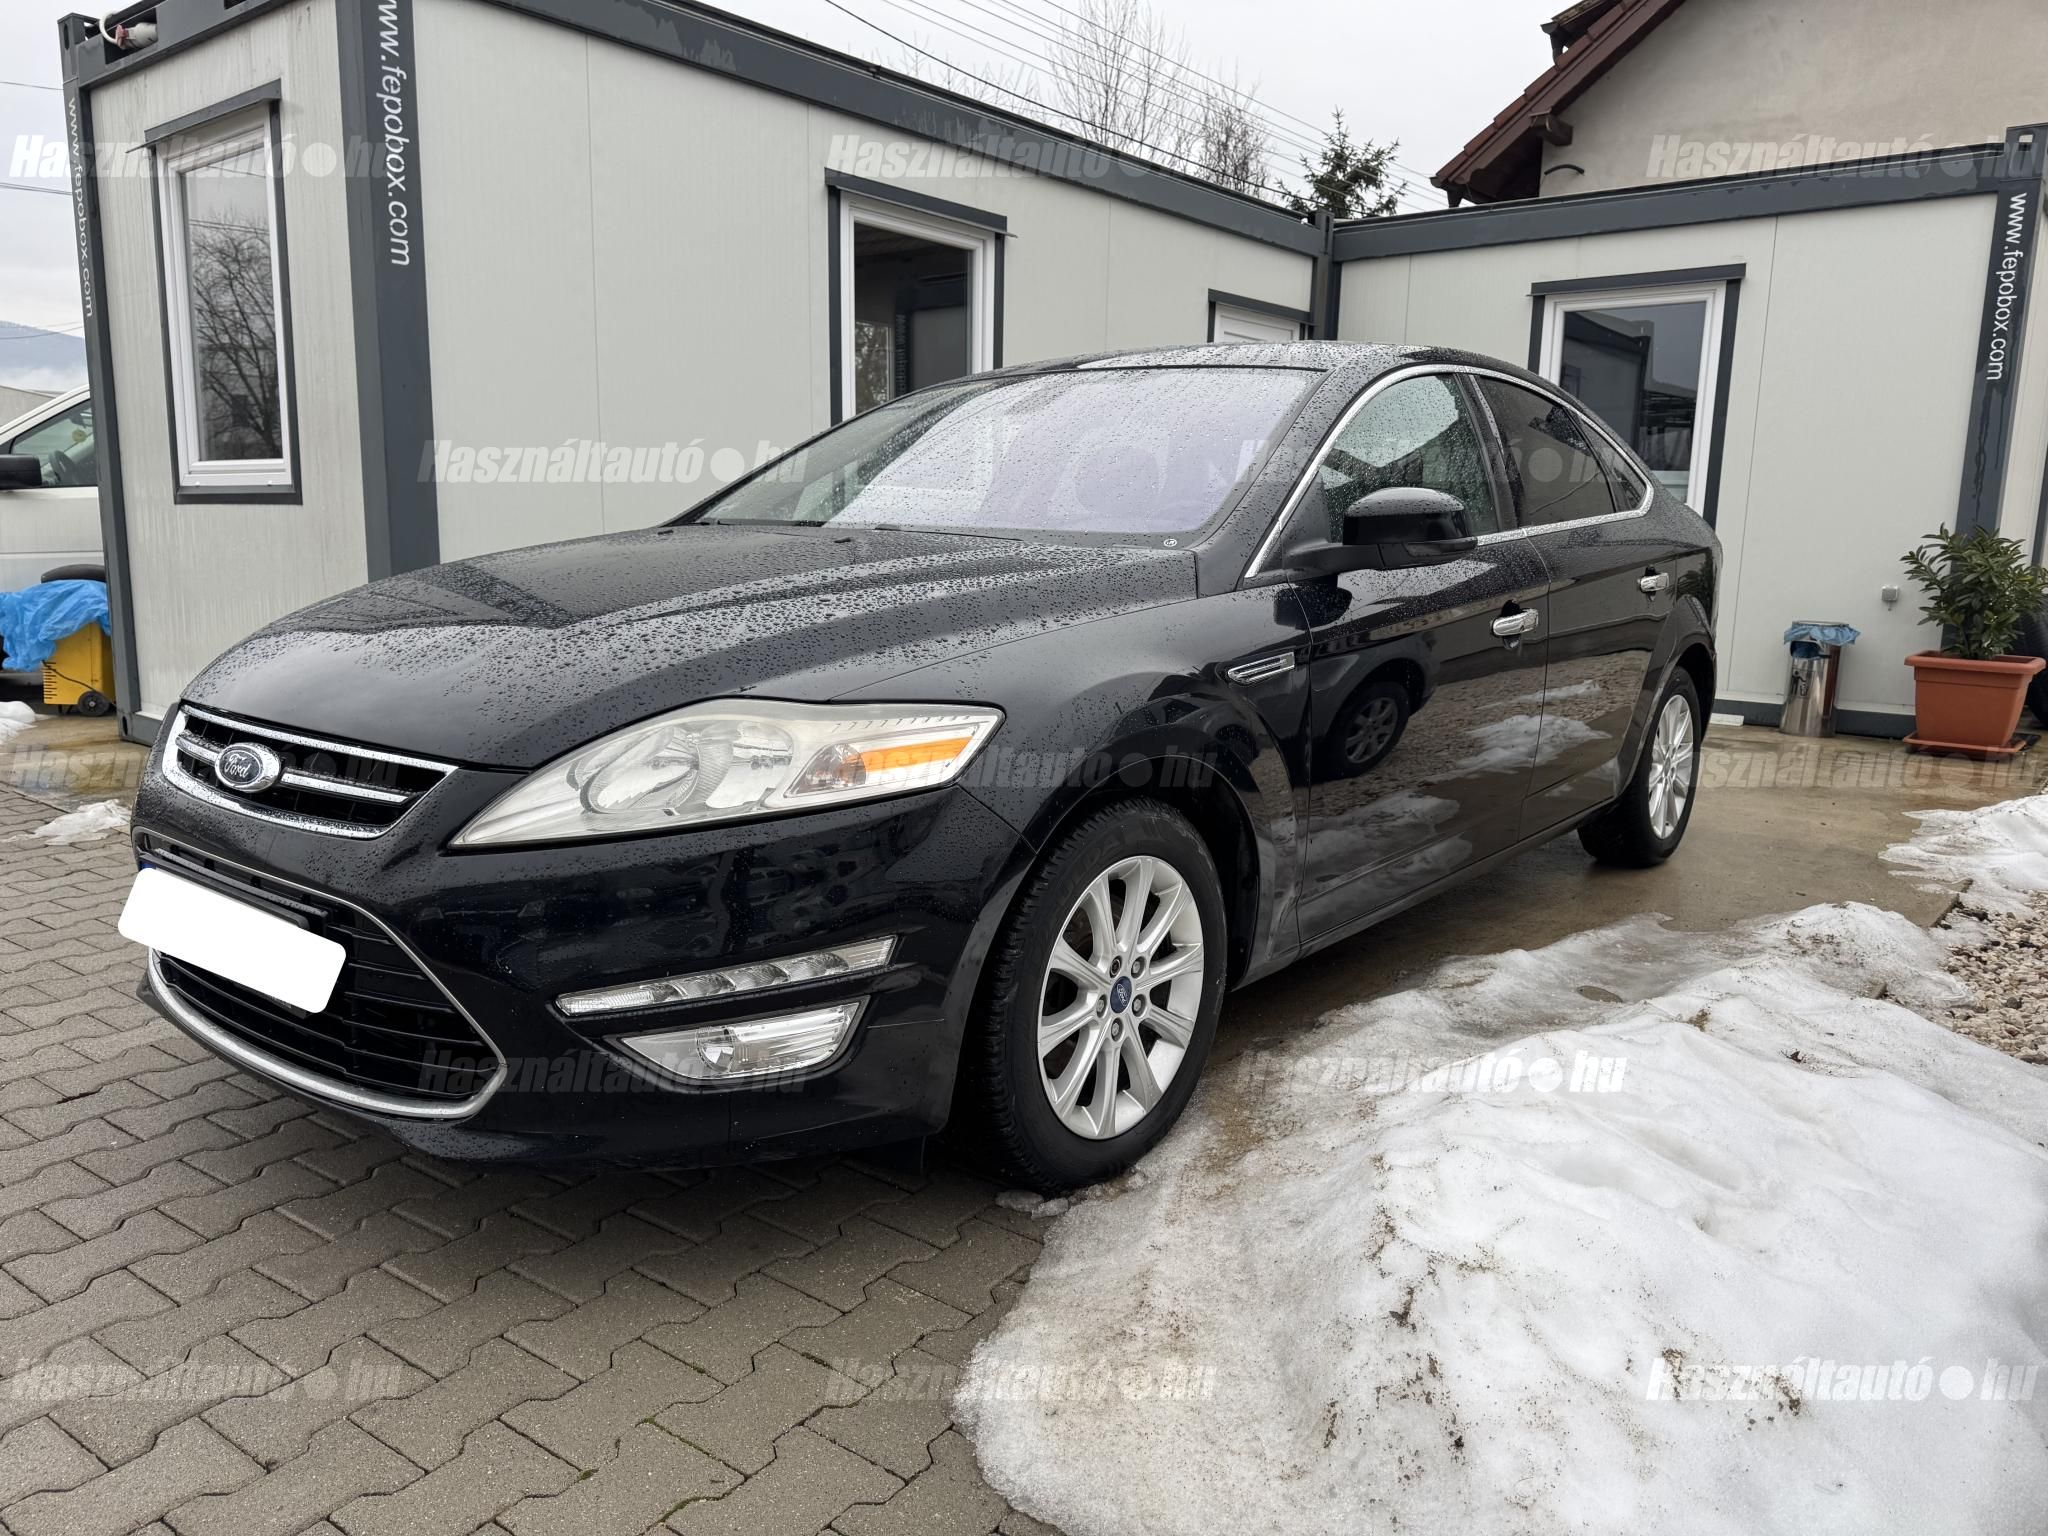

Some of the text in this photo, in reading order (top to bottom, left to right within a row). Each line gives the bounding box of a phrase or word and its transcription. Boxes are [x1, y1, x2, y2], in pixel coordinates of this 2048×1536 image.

[69, 98, 92, 317] www.fepobox.com
[376, 0, 409, 266] ww.fepobox.com
[1986, 192, 2028, 380] www.fepobox.com
[224, 753, 252, 779] Ford
